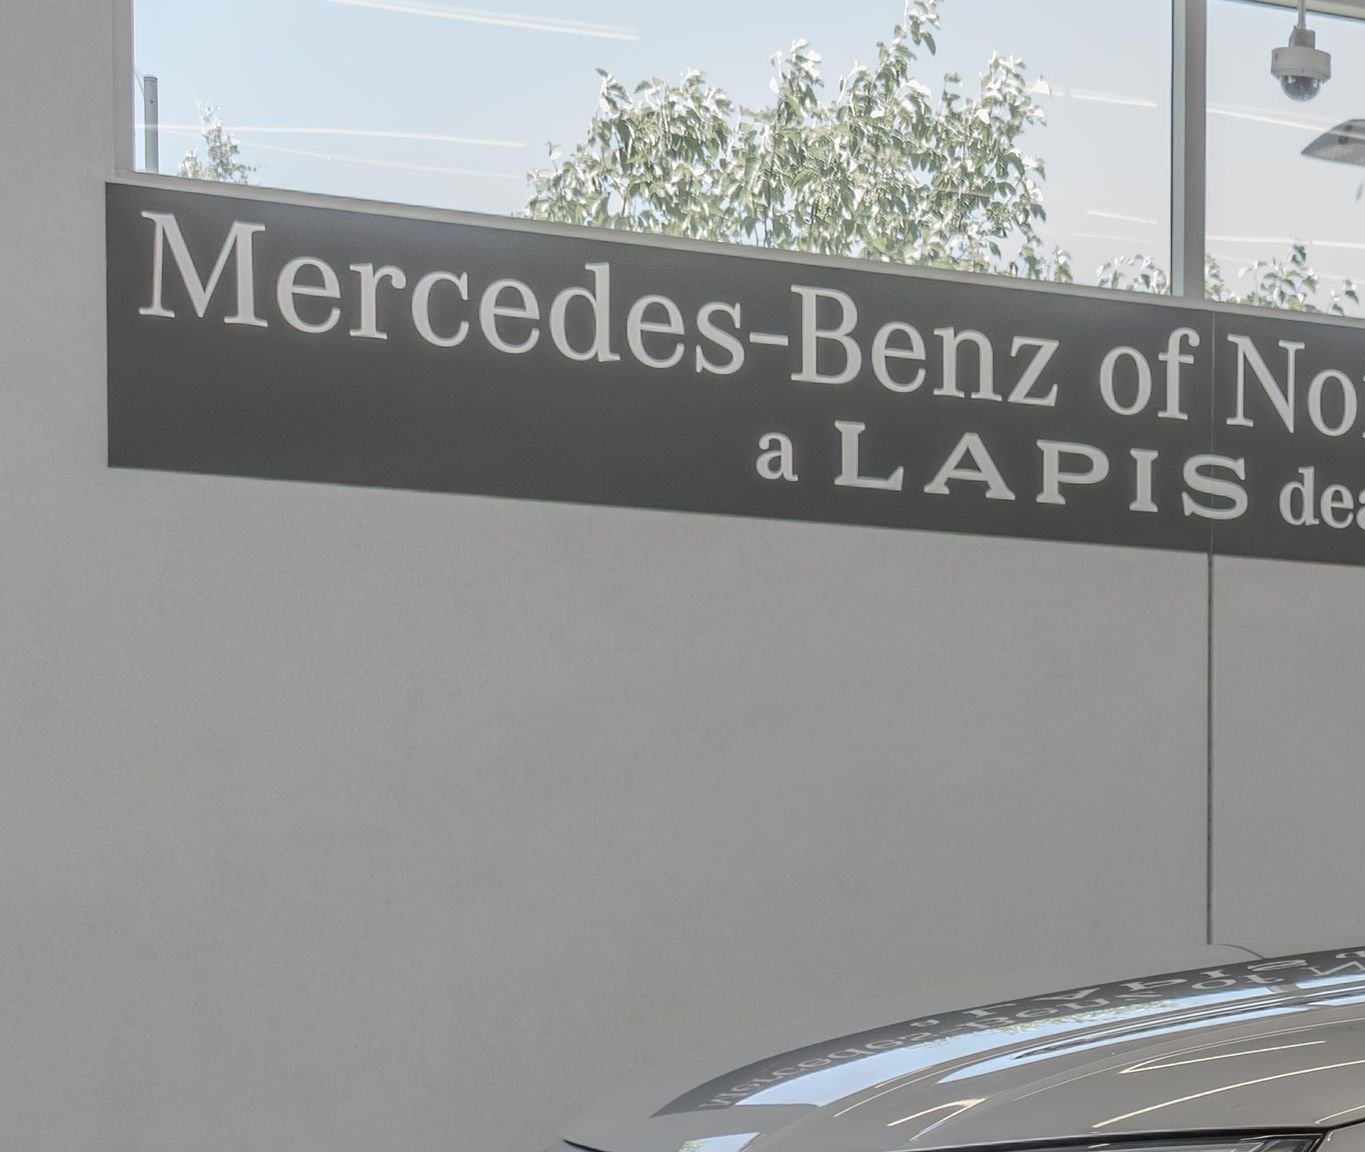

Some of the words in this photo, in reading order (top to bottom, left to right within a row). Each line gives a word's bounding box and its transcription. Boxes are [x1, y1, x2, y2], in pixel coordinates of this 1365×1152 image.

[139, 210, 1060, 407] Mercedes-Benz
[1098, 326, 1200, 421] of
[755, 431, 799, 482] a
[833, 420, 1249, 520] LAPIS
